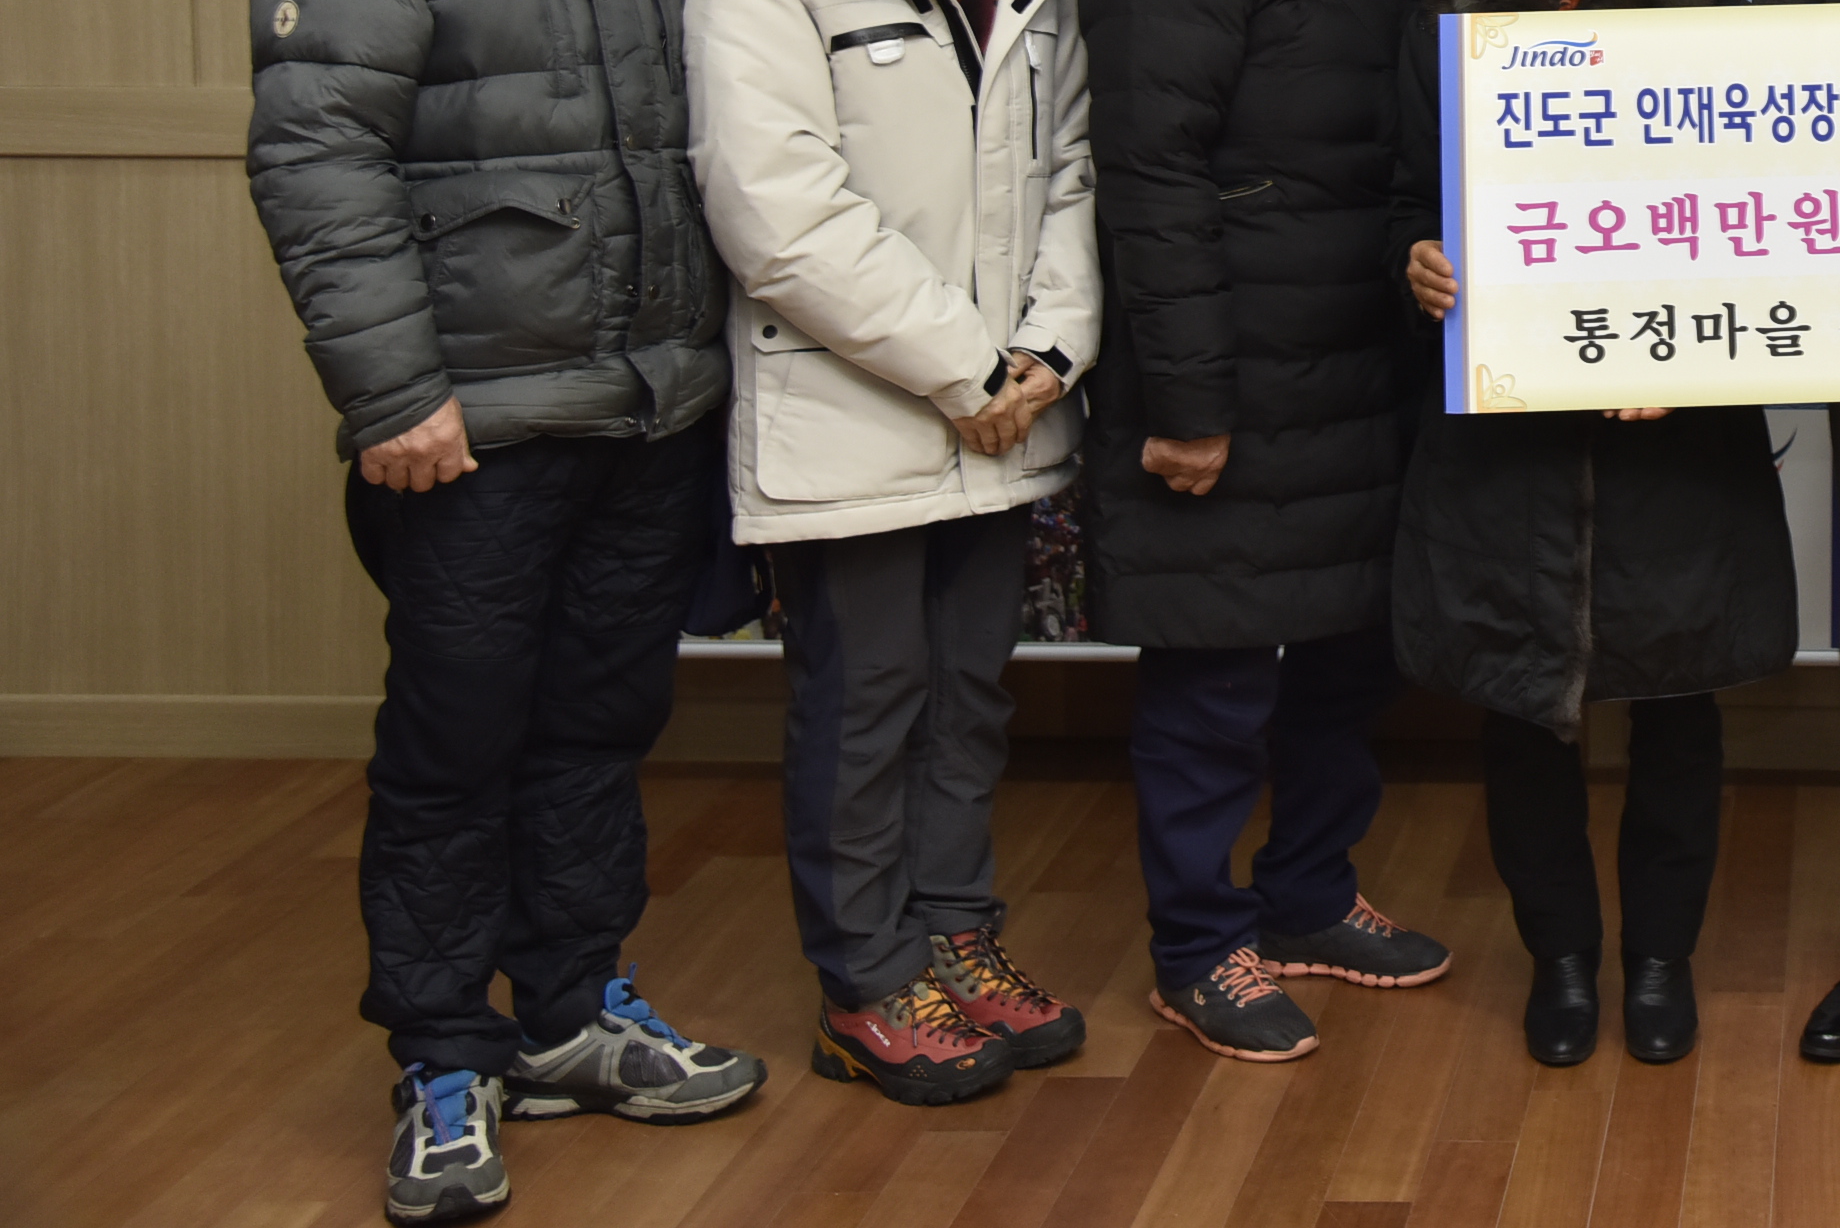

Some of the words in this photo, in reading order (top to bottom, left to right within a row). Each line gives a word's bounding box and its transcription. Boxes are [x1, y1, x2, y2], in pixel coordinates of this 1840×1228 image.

[1501, 45, 1587, 70] Jindo
[1495, 90, 1616, 149] 진도군
[1563, 300, 1812, 364] 통정마을
